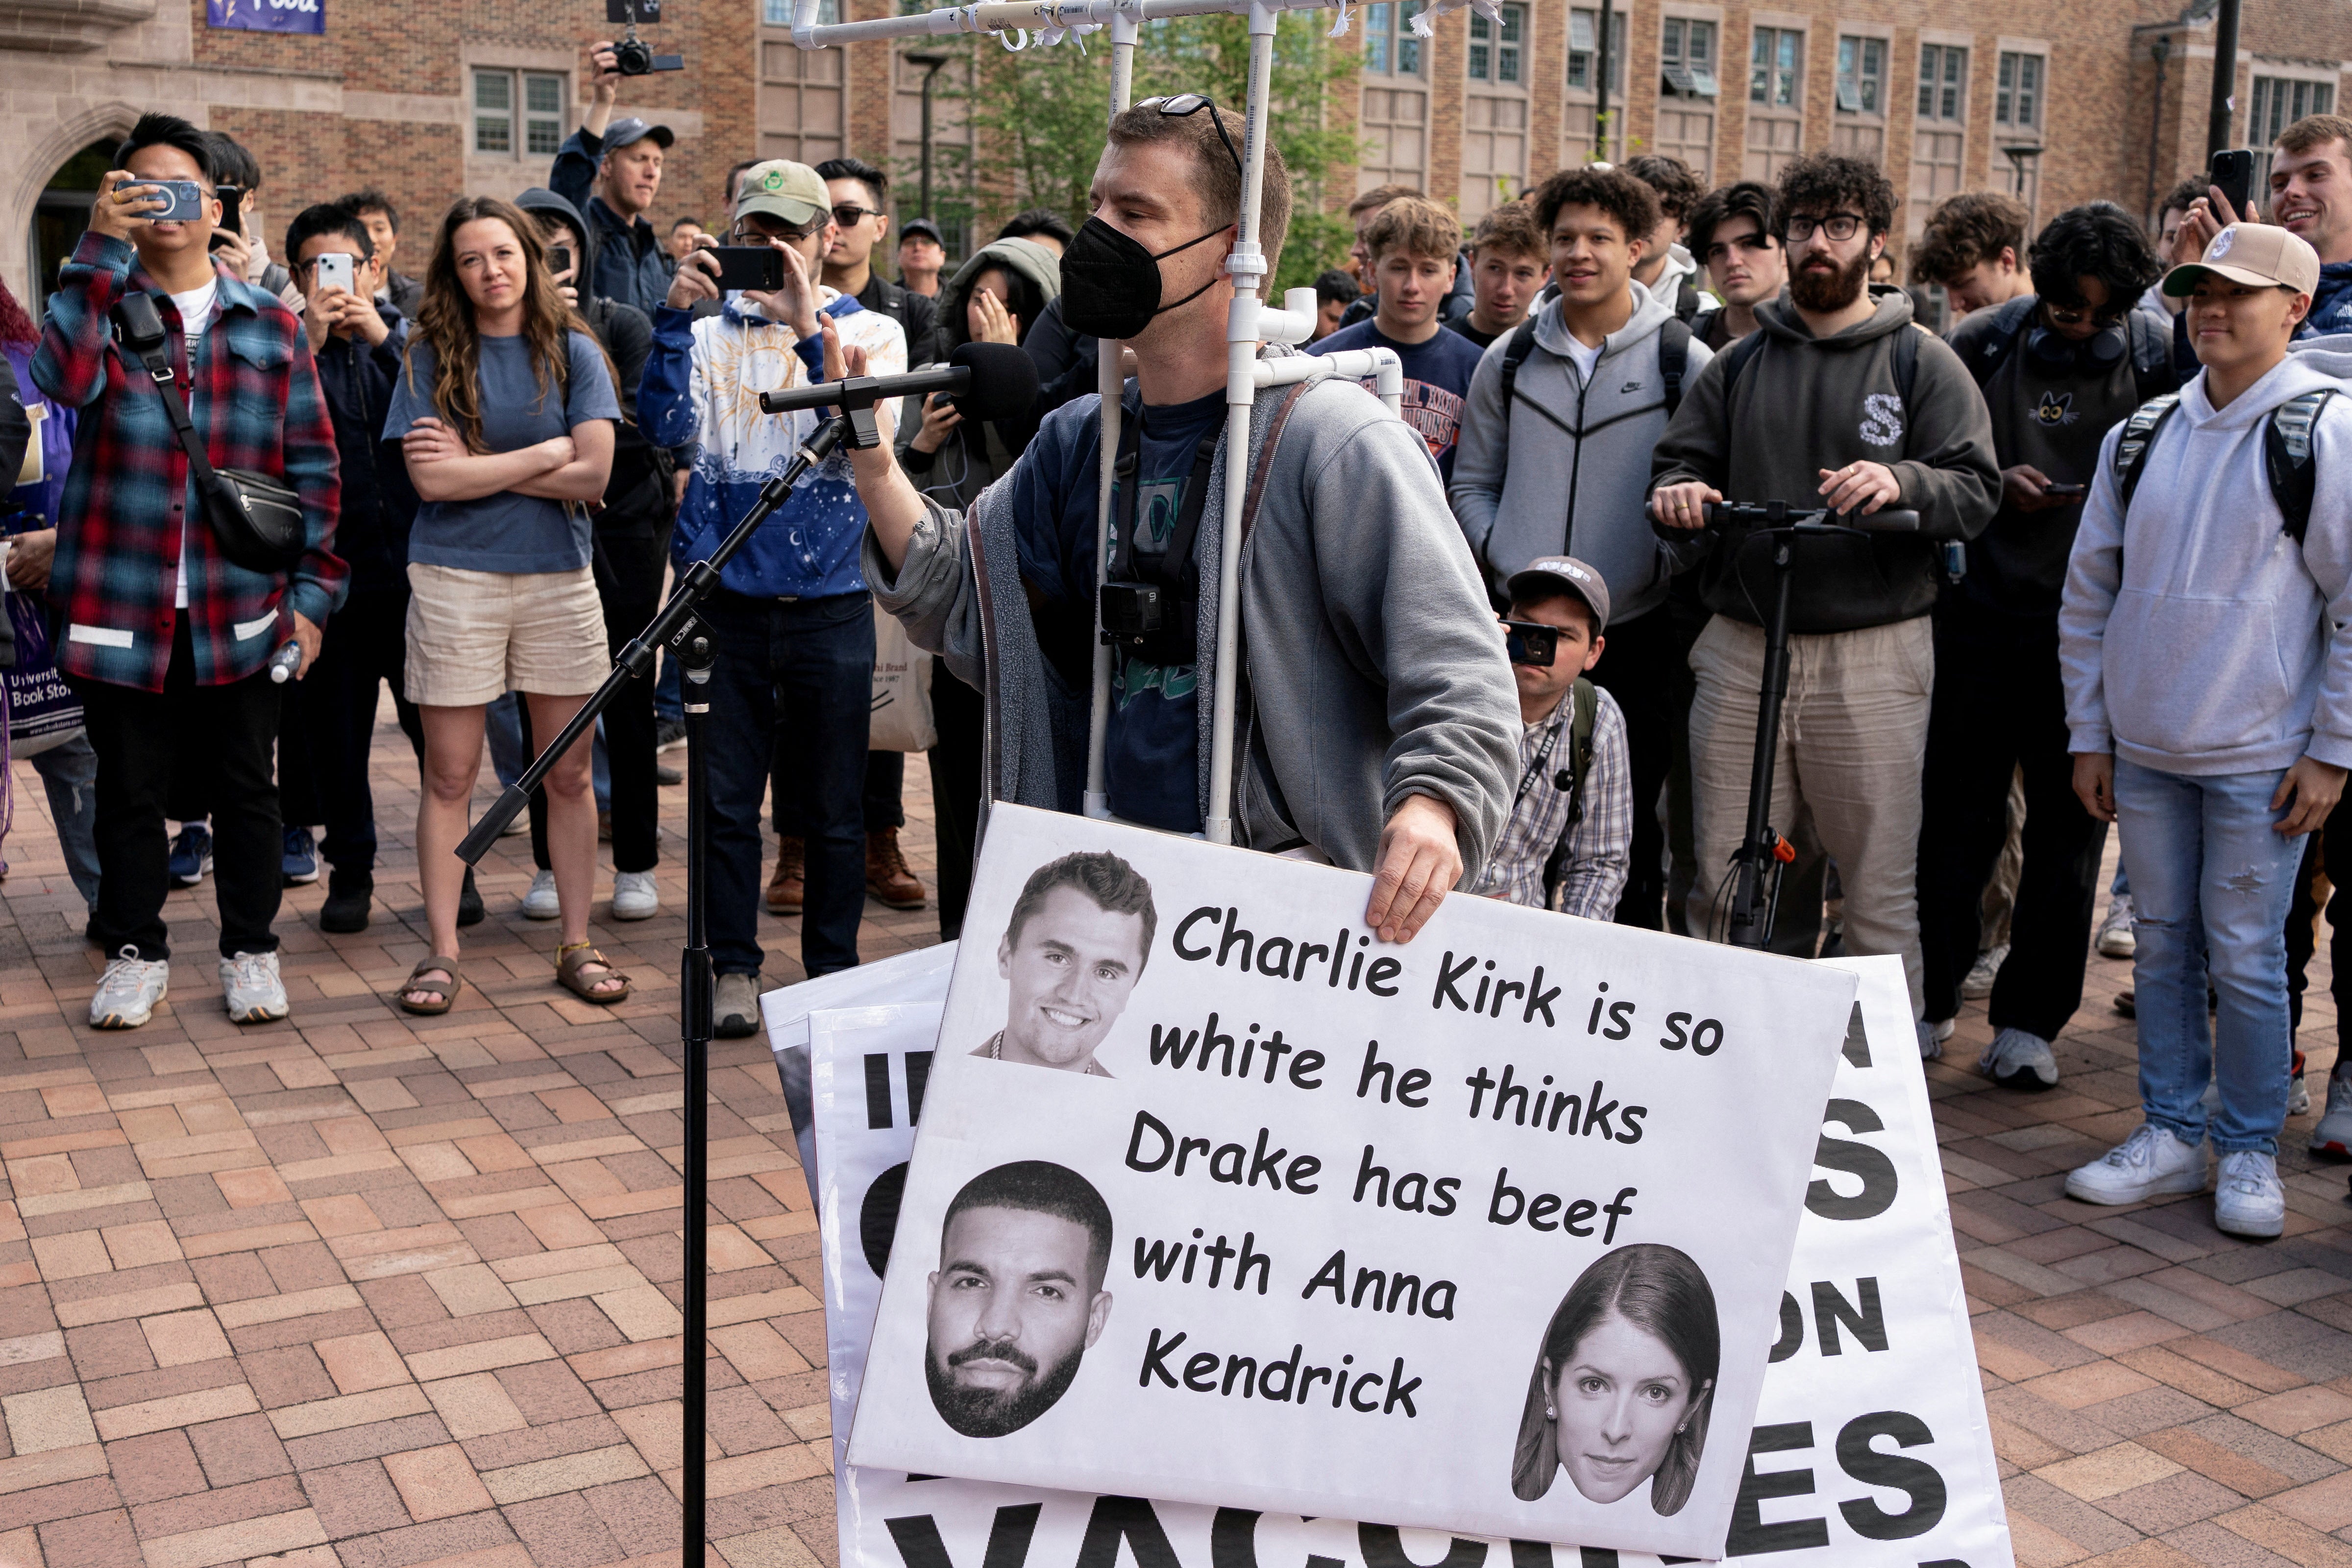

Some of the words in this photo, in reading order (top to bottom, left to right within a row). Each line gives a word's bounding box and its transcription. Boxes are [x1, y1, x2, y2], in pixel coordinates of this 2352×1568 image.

[1859, 393, 1903, 446] S
[1149, 592, 1156, 601] 9
[12, 686, 45, 707] Book
[1173, 906, 1402, 997] Charlie
[1432, 951, 1562, 1028] Kirk
[1587, 981, 1636, 1040] is
[1660, 1012, 1724, 1056] so
[1150, 1012, 1325, 1090] white
[1356, 1040, 1432, 1108] he
[1465, 1064, 1647, 1145] thinks
[1125, 1110, 1322, 1195] Drake
[1353, 1144, 1461, 1217] has
[1488, 1167, 1638, 1245] beef
[1134, 1227, 1271, 1295] with
[1301, 1249, 1457, 1321] Anna
[1139, 1328, 1422, 1418] Kendrick
